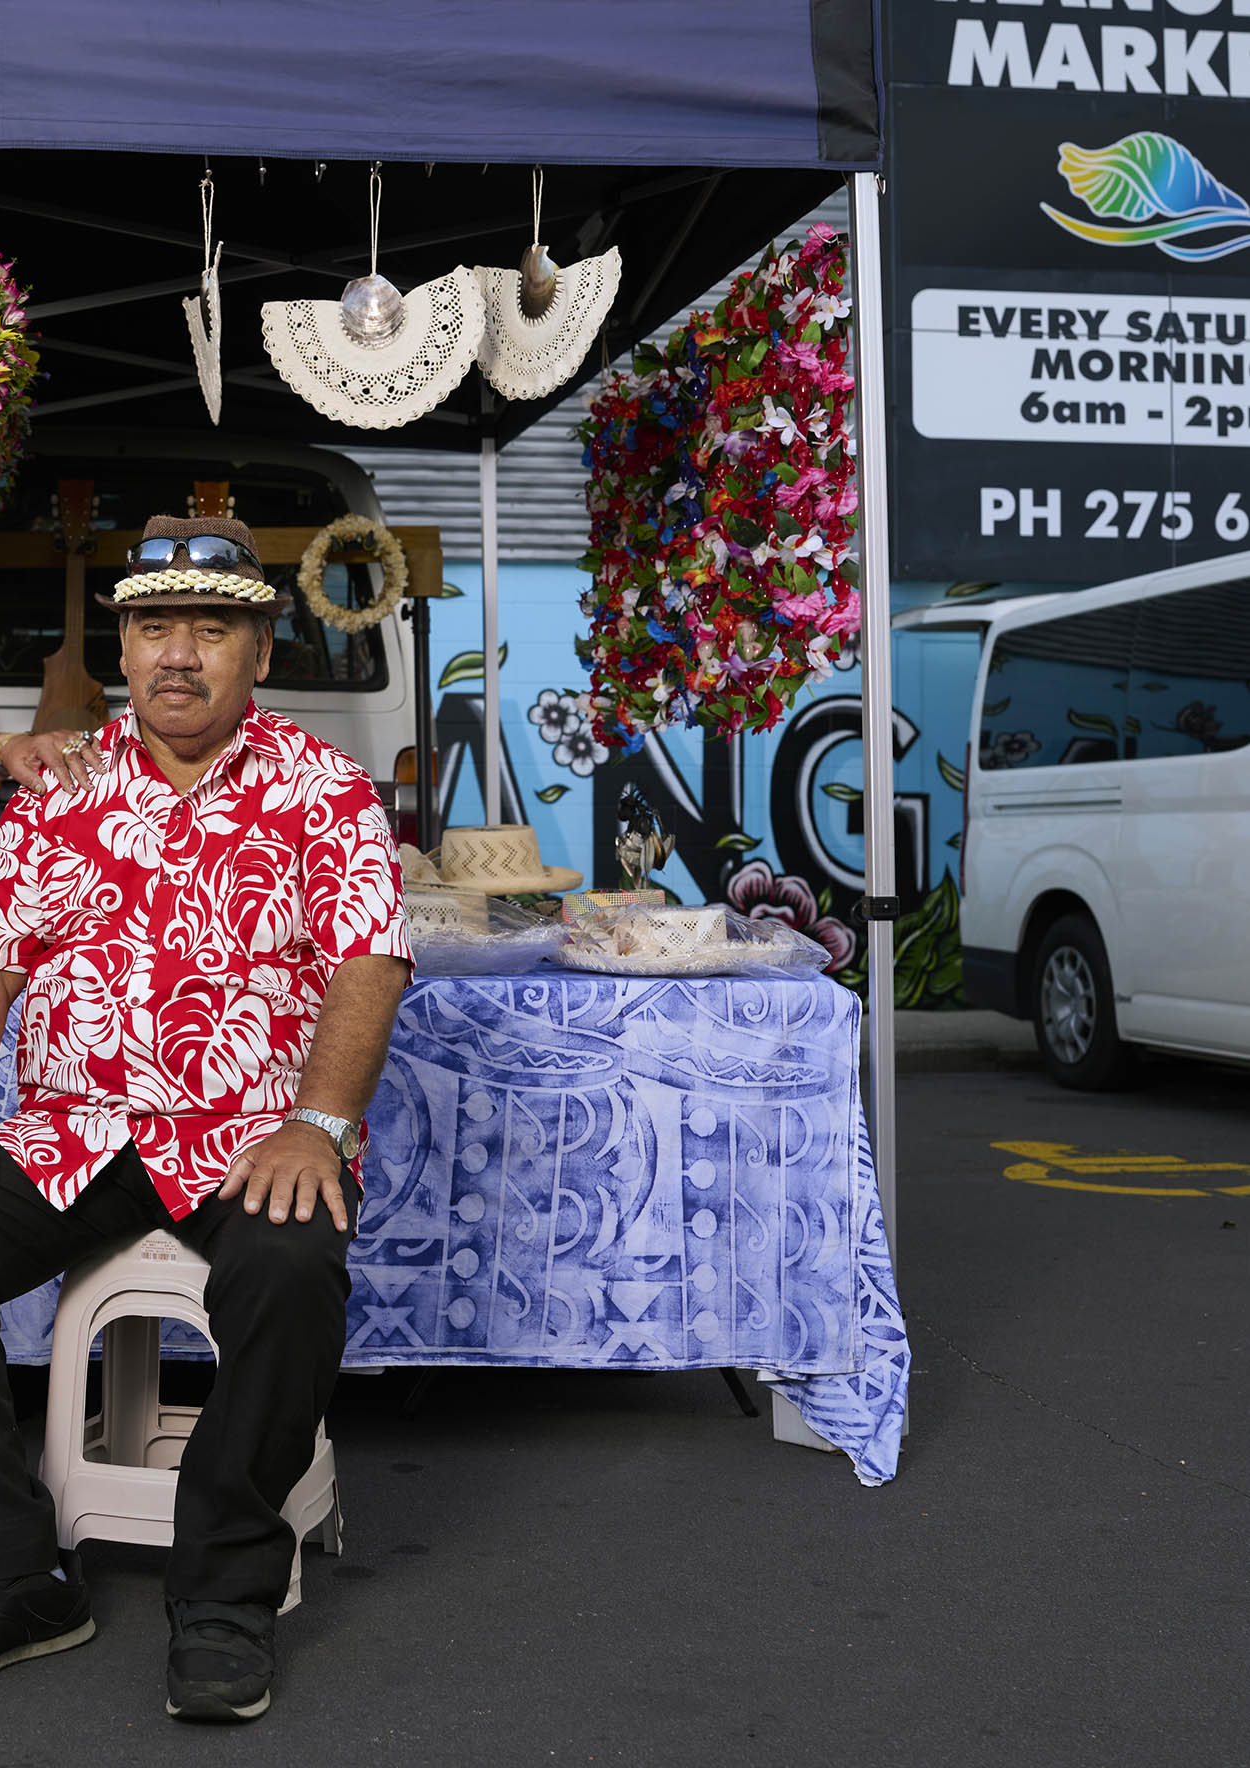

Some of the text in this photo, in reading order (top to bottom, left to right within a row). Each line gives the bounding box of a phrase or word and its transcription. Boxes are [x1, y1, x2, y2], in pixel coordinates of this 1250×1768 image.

[957, 305, 1246, 346] EVERY SATU
[1030, 348, 1250, 386] MORNIN
[1020, 391, 1250, 437] 6am - 2p
[980, 487, 1250, 542] PH 275 6
